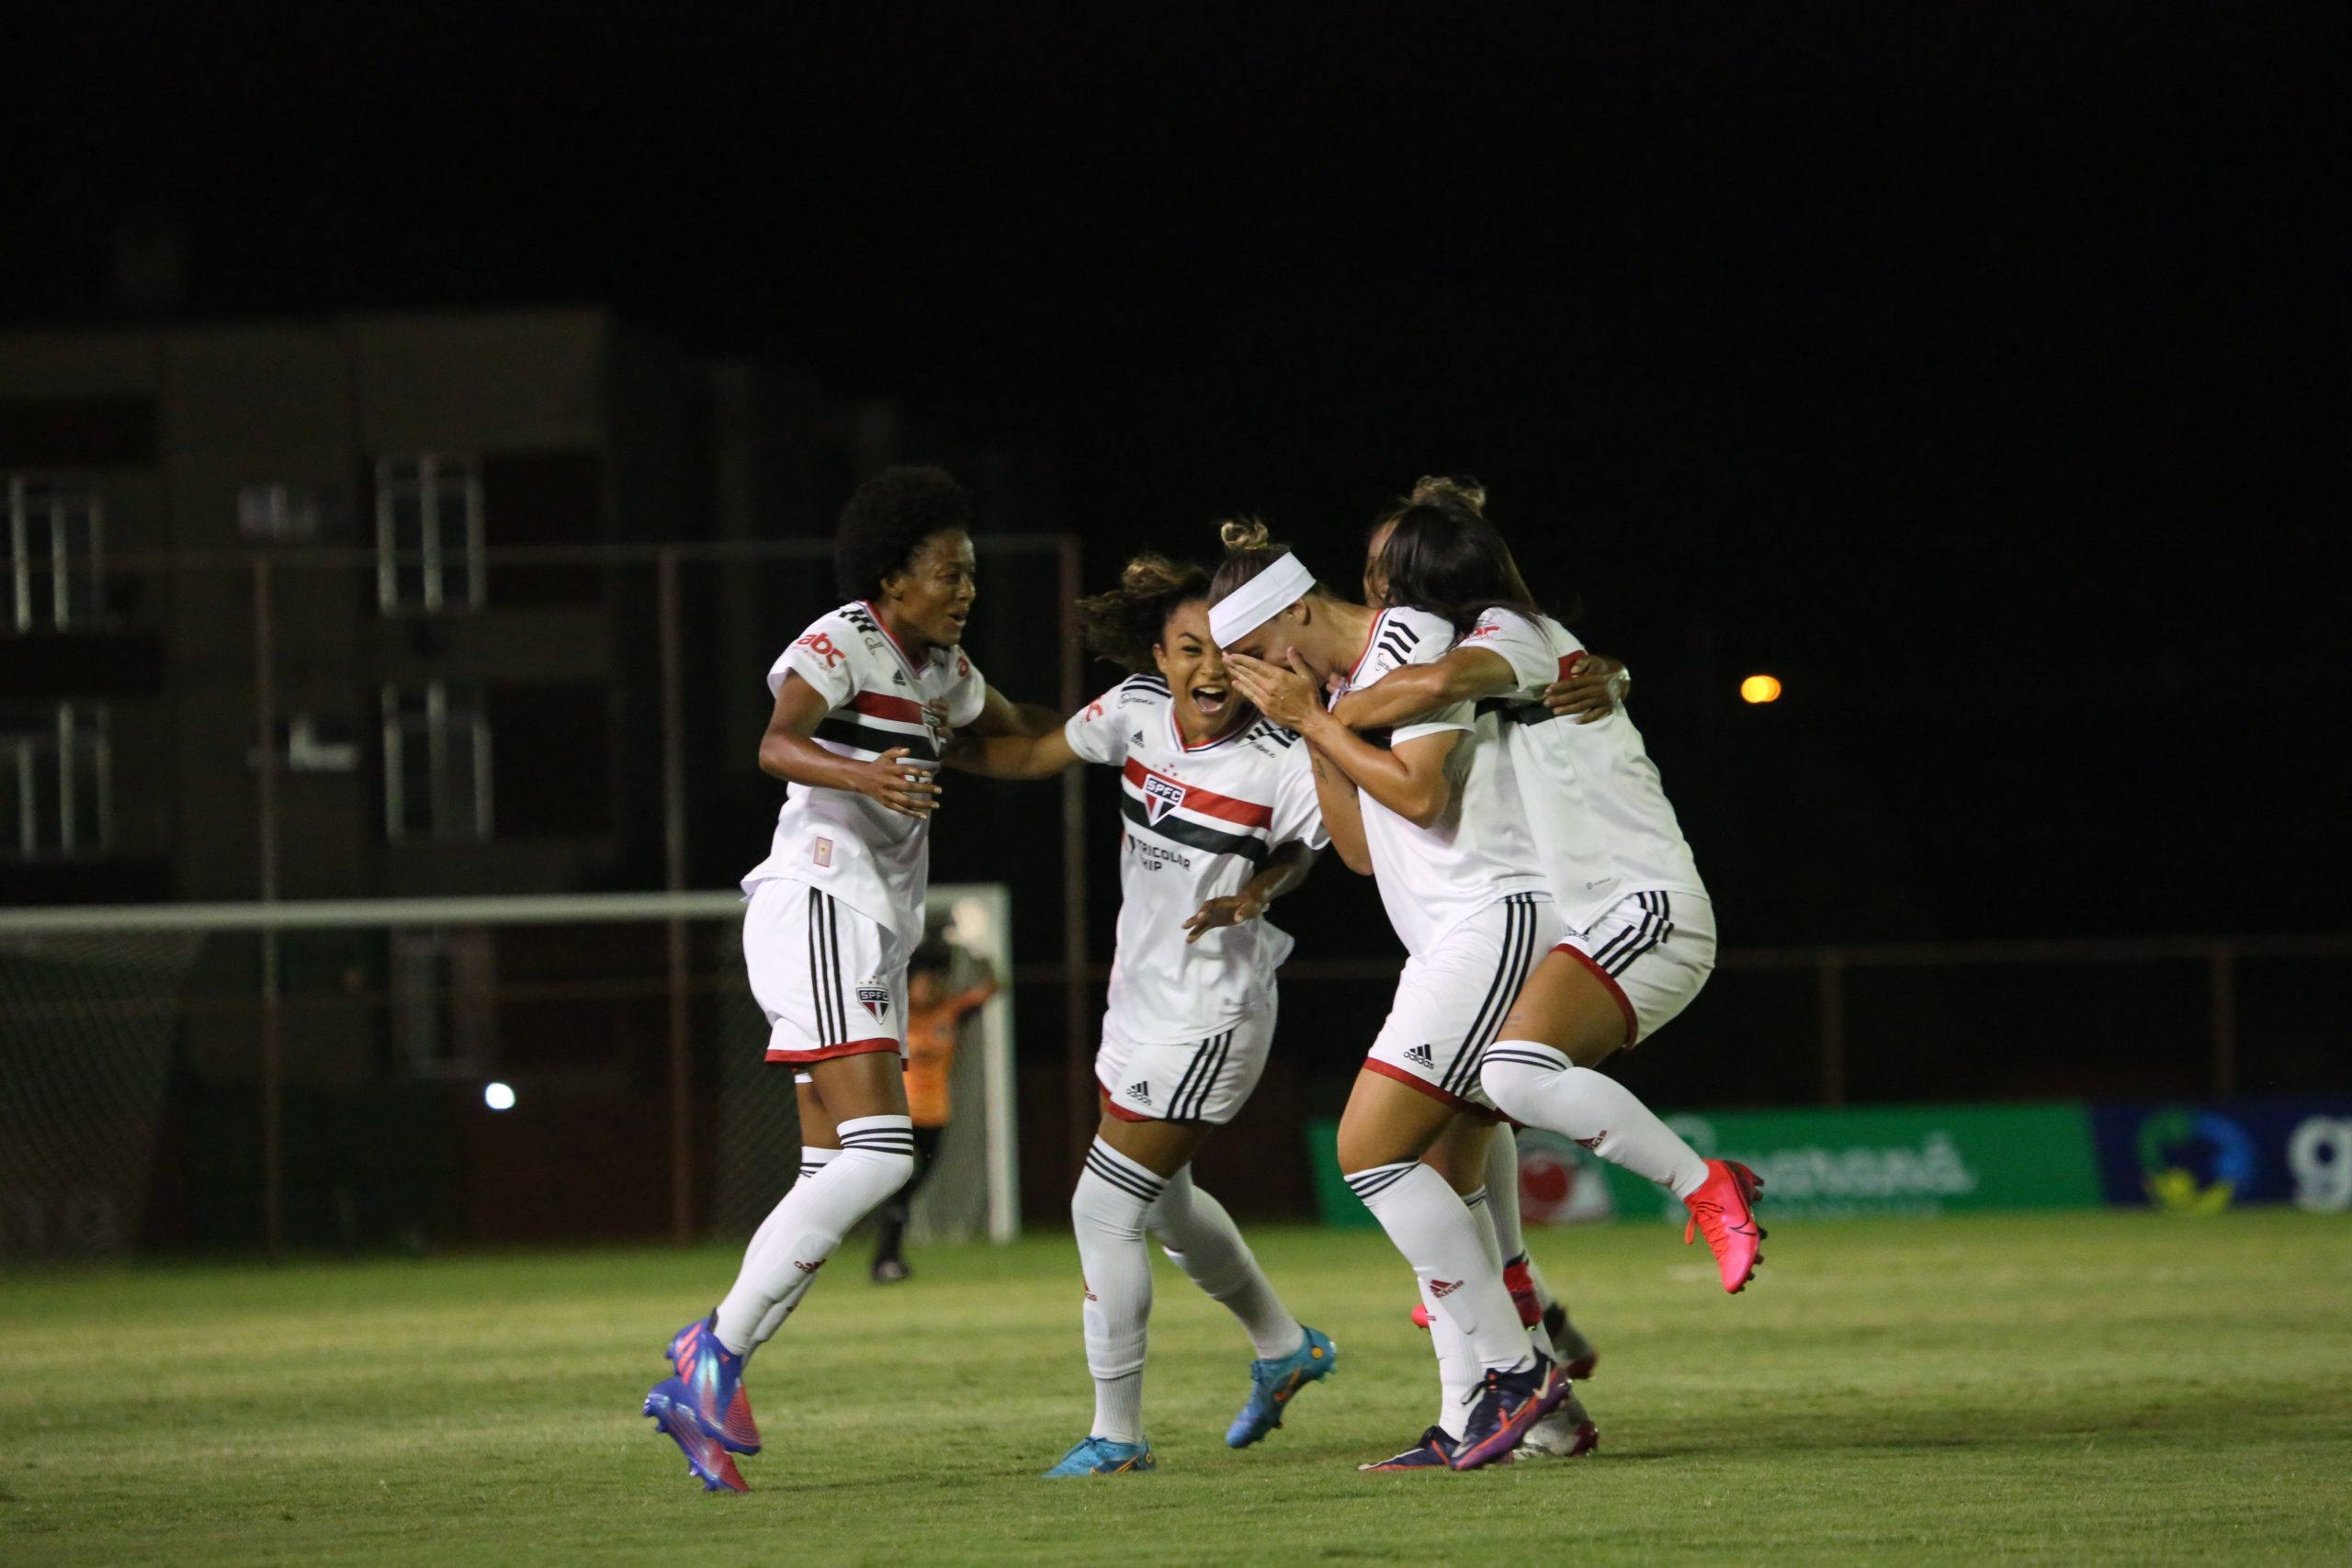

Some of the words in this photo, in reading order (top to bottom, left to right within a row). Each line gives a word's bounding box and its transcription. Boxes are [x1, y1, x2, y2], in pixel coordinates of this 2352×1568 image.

[797, 632, 846, 669] abc
[1147, 779, 1182, 801] SPFC
[860, 991, 889, 1001] SPFC
[1404, 1052, 1435, 1070] adidas
